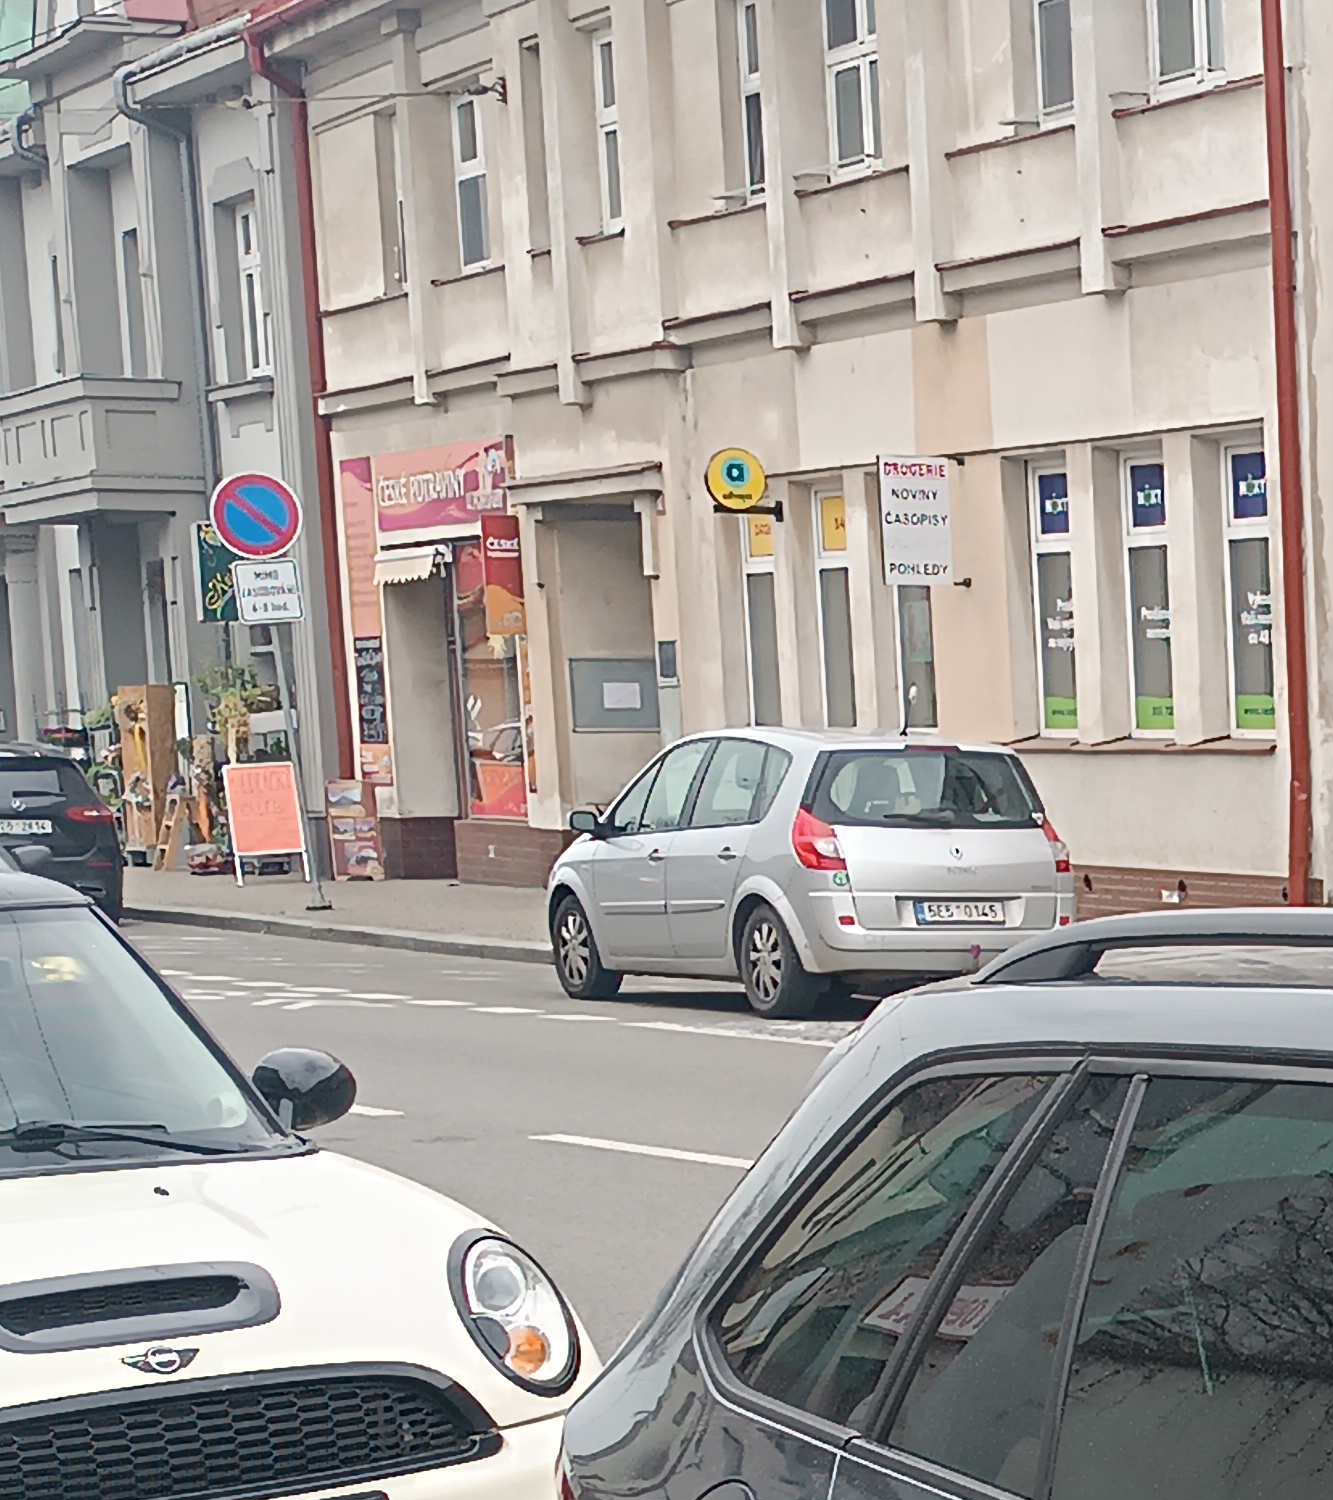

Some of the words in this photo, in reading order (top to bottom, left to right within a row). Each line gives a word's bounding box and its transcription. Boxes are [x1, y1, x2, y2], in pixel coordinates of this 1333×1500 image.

[883, 461, 947, 478] DROGERIE
[891, 487, 938, 501] NOVINY
[884, 510, 949, 527] ČASOPISY
[889, 562, 948, 577] POHLEDY
[927, 904, 954, 919] 5E5
